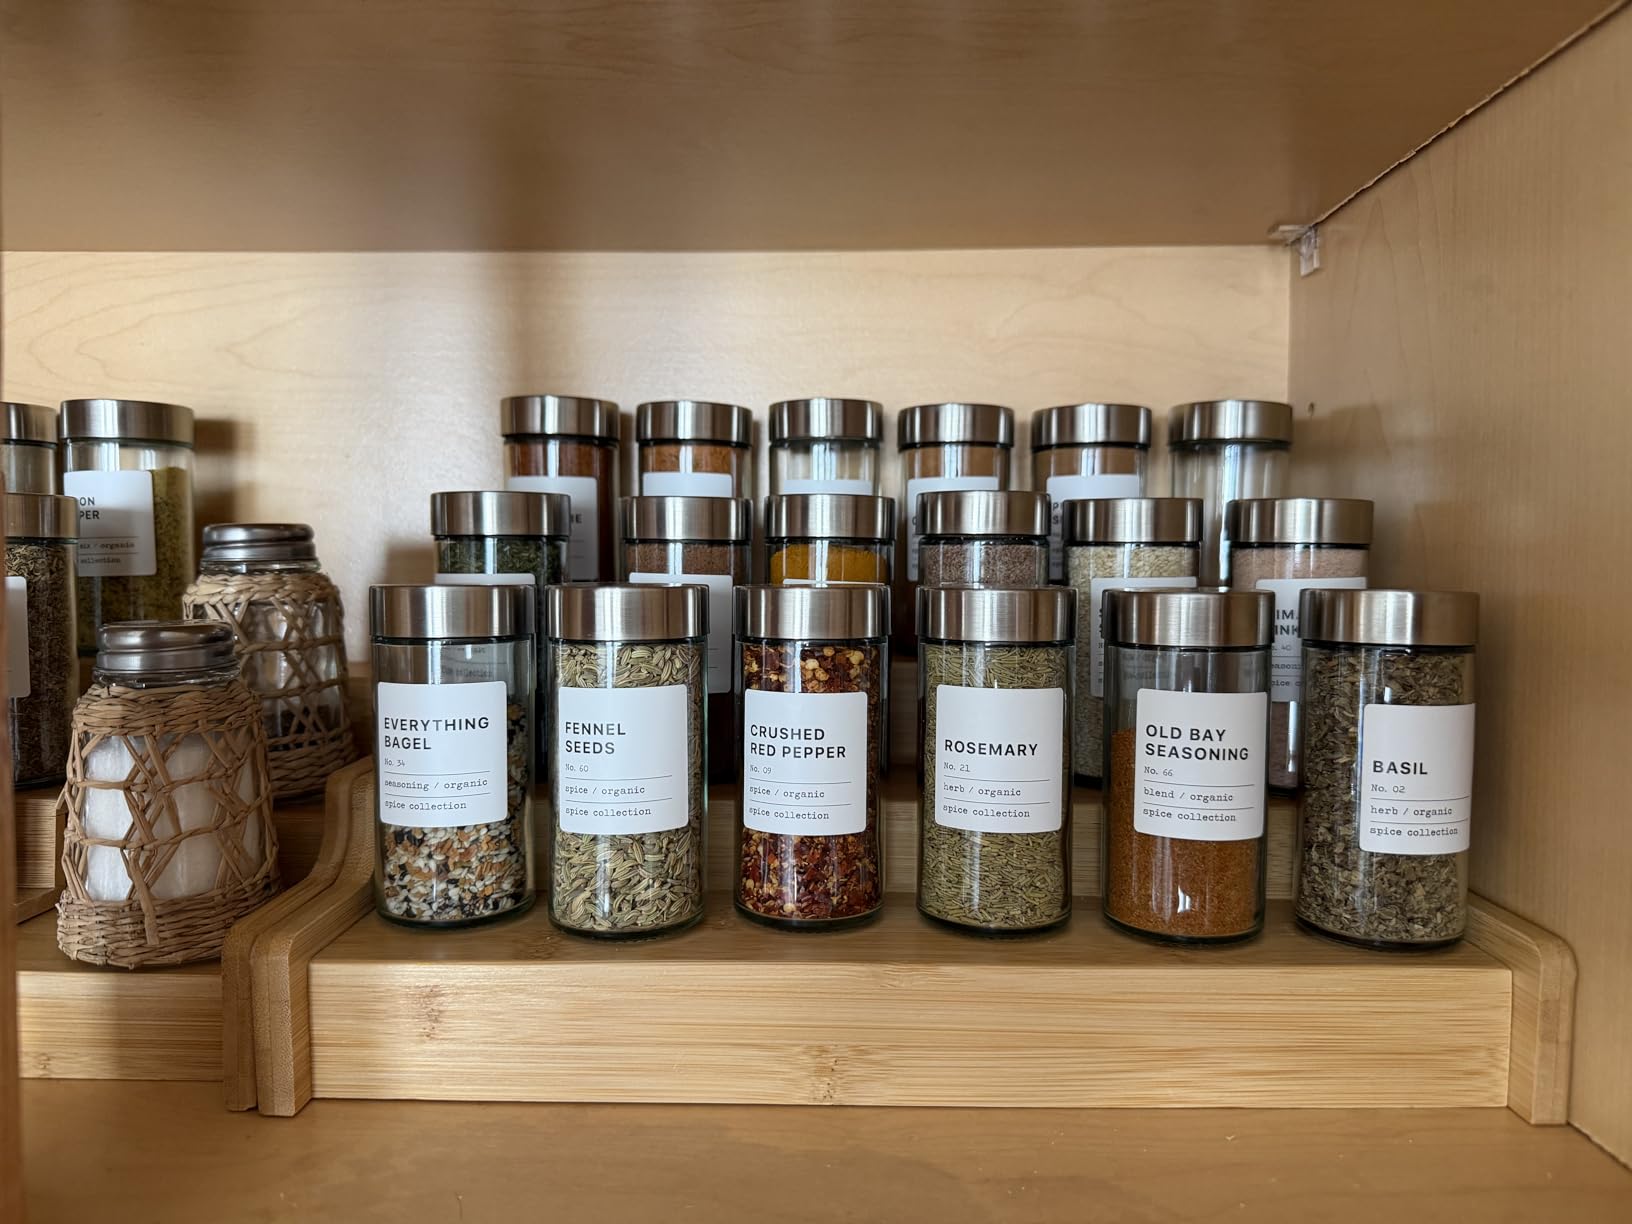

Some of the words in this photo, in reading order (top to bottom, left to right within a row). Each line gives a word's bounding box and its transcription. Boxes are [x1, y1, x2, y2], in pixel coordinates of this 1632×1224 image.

[80, 497, 95, 506] ON
[80, 510, 100, 520] PER
[385, 717, 489, 731] EVERYTHING
[566, 722, 626, 735] FENNEL
[751, 724, 824, 740] CRUSHED
[1146, 724, 1182, 739] OLD
[1190, 728, 1226, 742] BAY
[385, 736, 431, 749] BAGEL
[566, 740, 614, 754] SEEDS
[945, 739, 1037, 756] ROSEMARY
[751, 742, 776, 756] RED
[782, 746, 845, 758] PEPPER
[1145, 743, 1248, 760] SEASONING
[384, 758, 395, 767] No.
[397, 759, 405, 767] 34
[565, 763, 577, 772] No.
[579, 763, 589, 773] 60
[944, 762, 956, 771] No.
[959, 763, 971, 772] 21
[1373, 760, 1428, 775] BASIL
[750, 765, 761, 774] No.
[762, 766, 771, 775] 09
[1144, 766, 1159, 775] No.
[1162, 767, 1174, 777] 66
[385, 780, 429, 793] seasoning
[444, 779, 487, 792] organic
[565, 785, 588, 797] spice
[602, 786, 645, 797] organic
[749, 784, 771, 798] spice
[783, 790, 824, 801] organic
[944, 782, 965, 795] herb
[978, 788, 1021, 799] organic
[1371, 784, 1387, 792] No.
[1392, 785, 1405, 794] 02
[1144, 787, 1175, 800] blend
[1190, 793, 1233, 804] organic
[385, 799, 406, 811] spice
[410, 799, 467, 810] collection
[566, 807, 588, 816] spice
[593, 808, 651, 816] collection
[943, 802, 968, 814] spice
[972, 805, 1030, 817] collection
[1371, 805, 1398, 815] herb
[1413, 807, 1452, 818] organic
[749, 805, 770, 816] spice
[774, 808, 829, 819] collection
[1143, 806, 1172, 818] spice
[1177, 810, 1236, 822] collection
[1370, 827, 1402, 836] spice
[1407, 825, 1458, 837] collection
